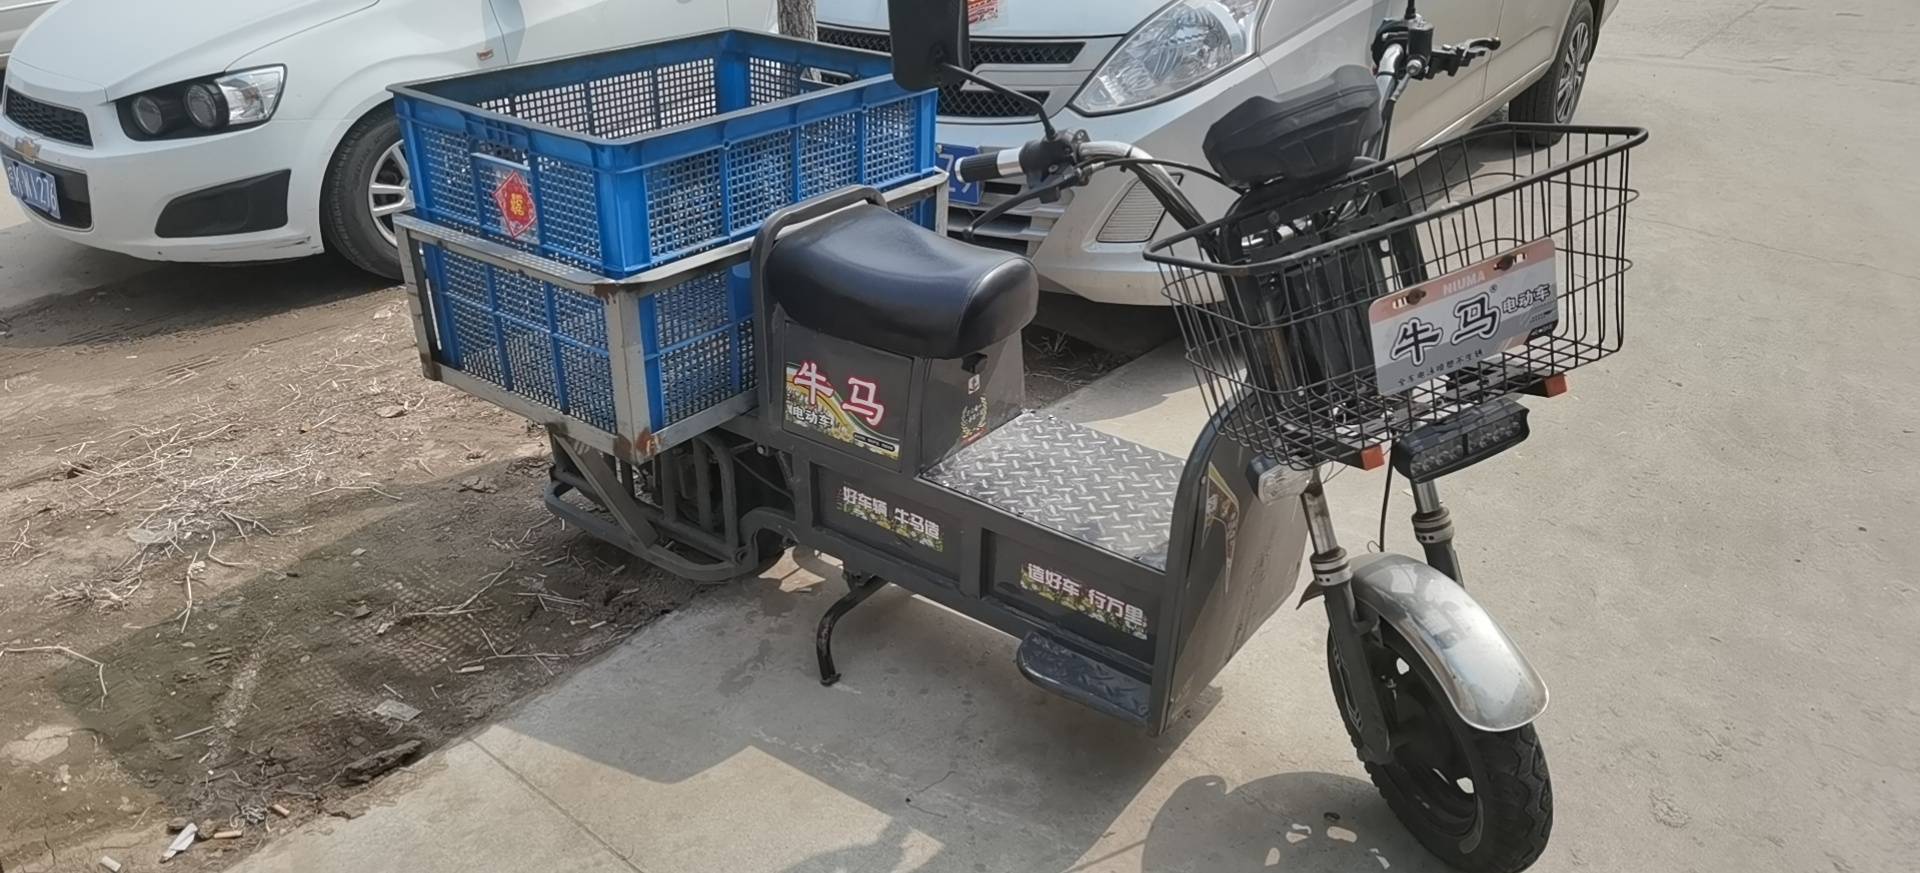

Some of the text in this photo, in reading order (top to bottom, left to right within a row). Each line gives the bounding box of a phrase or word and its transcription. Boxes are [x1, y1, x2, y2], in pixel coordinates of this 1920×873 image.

[1443, 271, 1486, 296] NIUMA
[1502, 284, 1551, 314] 电动车
[792, 405, 833, 428] 电动车
[1088, 589, 1144, 626] 行万里
